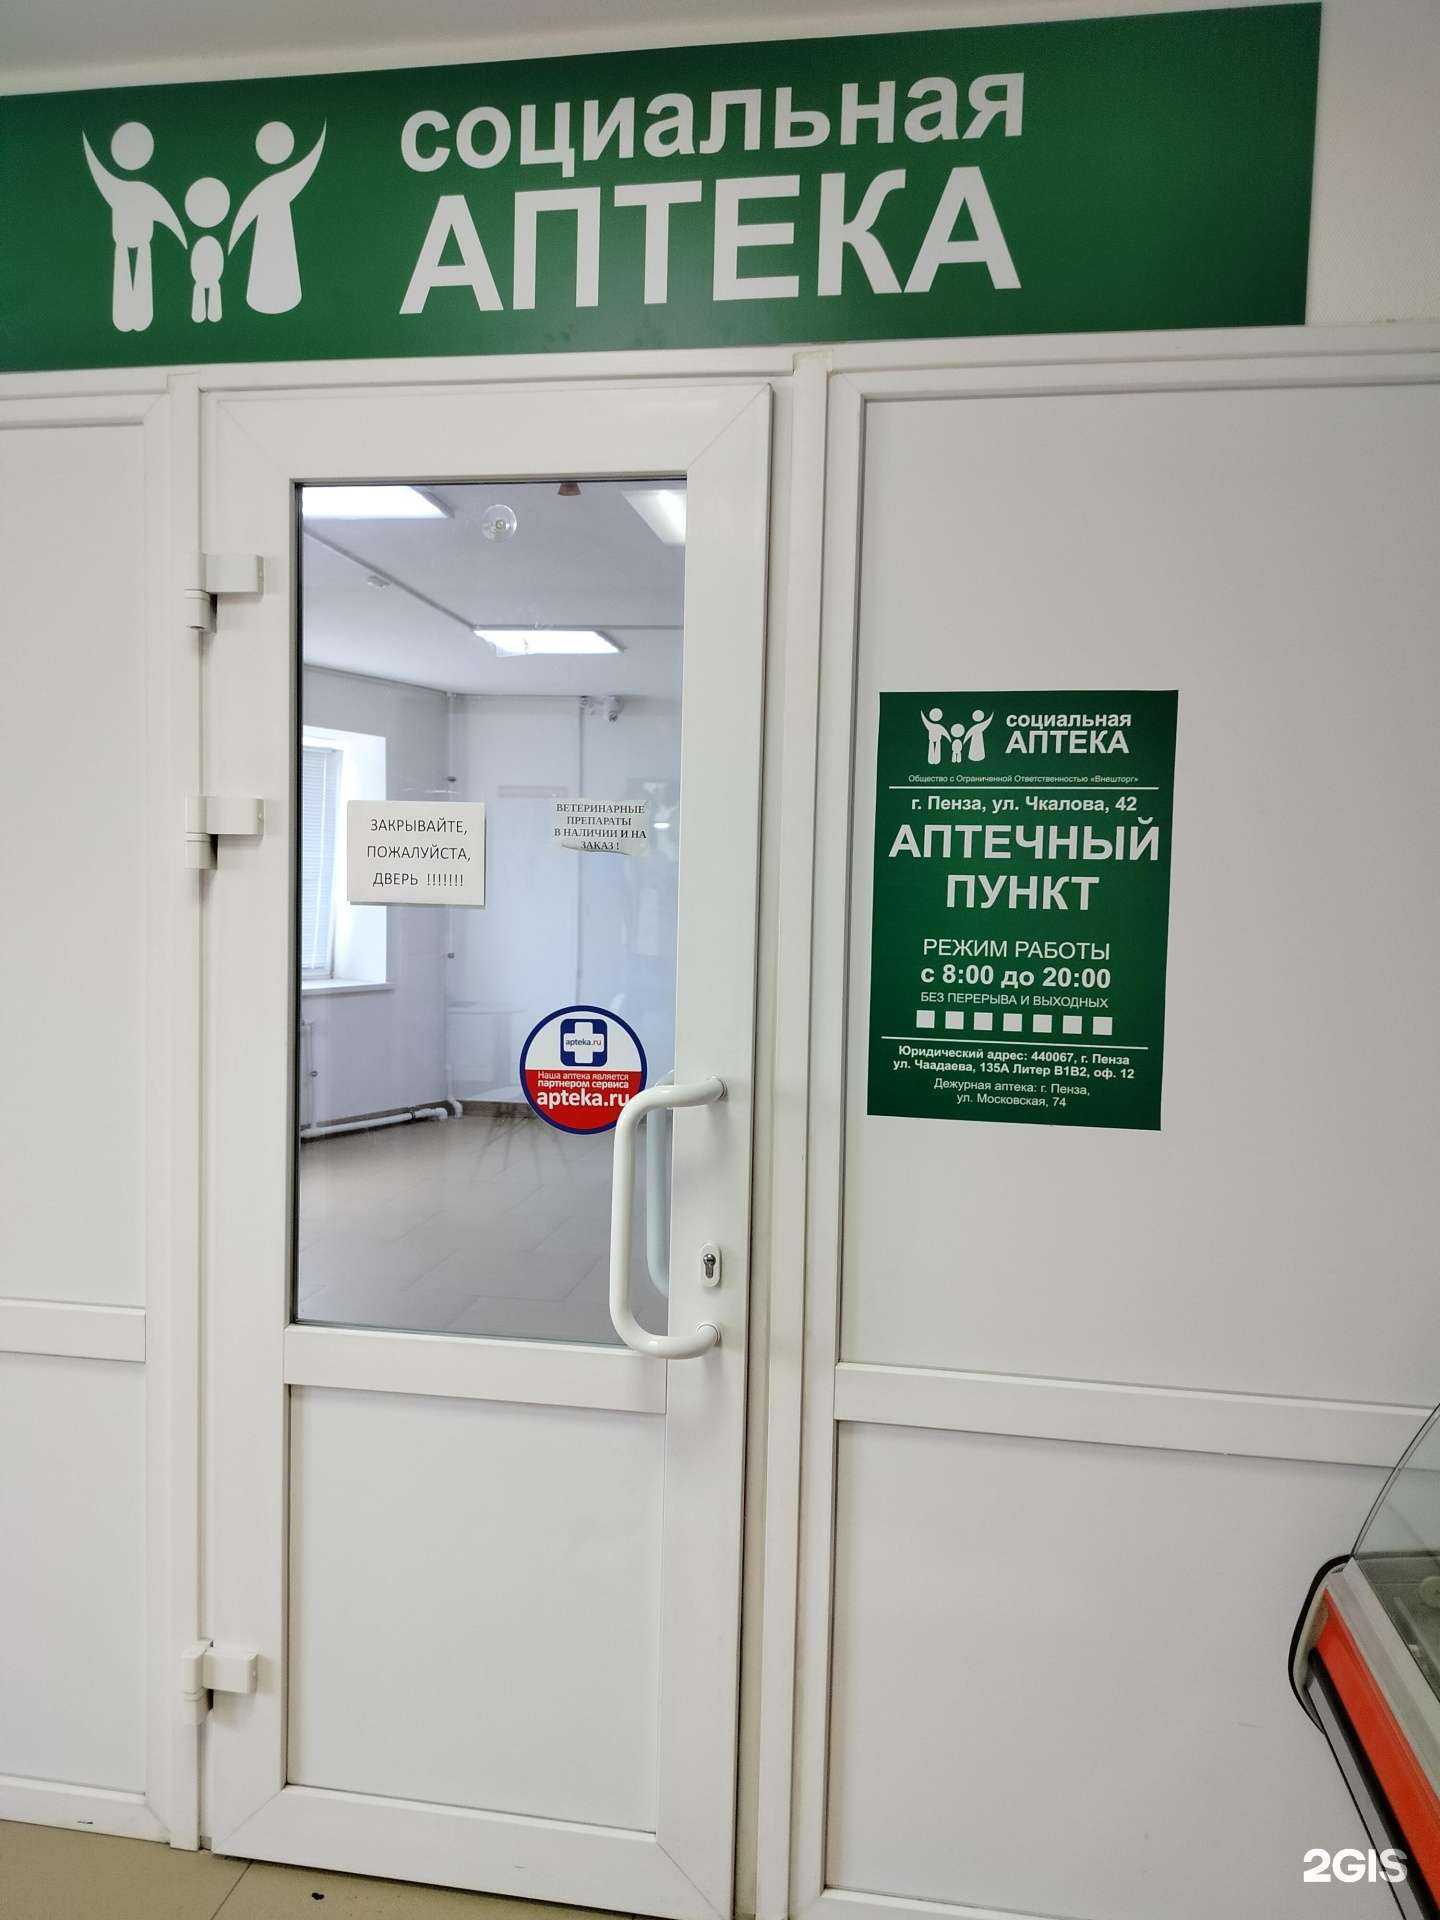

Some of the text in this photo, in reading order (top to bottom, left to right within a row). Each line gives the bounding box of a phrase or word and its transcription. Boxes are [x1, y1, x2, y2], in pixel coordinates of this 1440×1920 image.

[401, 72, 1025, 178] социальная
[399, 165, 1022, 315] АПТЕКА
[1006, 713, 1132, 730] социальная
[1005, 729, 1130, 754] АПТЕКА
[908, 775, 948, 783] Общество
[956, 775, 1012, 784] Ограниченной
[1014, 775, 1088, 784] Ответственностью
[556, 803, 645, 814] ВЕТЕРИНАРНЫЕ
[911, 795, 1137, 813] г. Пенза, ул. Чкалова, 42
[370, 817, 468, 836] ЗАКРЫВАЙТЕ,
[567, 816, 632, 826] ПРЕПАРАТЫ
[554, 828, 647, 839] В НАЛИЧИИ И НА
[888, 816, 1160, 861] АПТЕЧНЫЙ
[367, 844, 471, 862] ПОЖАЛУЙСТА,
[580, 840, 614, 850] ЗАКАЗ
[372, 871, 463, 887] ДВЕРЬ !!!!!!!
[946, 874, 1100, 911] ПУНКТ
[923, 938, 1110, 960] РЕЖИМ РАБОТЫ
[921, 964, 1111, 989] с 8:00 до 20:00
[921, 992, 1109, 1009] БЕЗ ПЕРЕРЫВА И ВЫХОДНЫХ
[566, 1037, 602, 1048] apteka.ru
[899, 1045, 1130, 1065] Юридический адрес: 440067, г. Пенза
[538, 1071, 629, 1081] Наша аптека является
[893, 1059, 911, 1070] ул.
[914, 1059, 976, 1073] Чаадаева,
[980, 1062, 1010, 1073] 135А
[1012, 1063, 1051, 1077] Литер
[1093, 1067, 1117, 1080] оф.
[1120, 1068, 1135, 1079] 12
[538, 1080, 629, 1090] партнером сервиса
[933, 1077, 1090, 1096] Дежурная аптека: г. Пенза,
[537, 1088, 629, 1109] apteka.ru
[956, 1093, 1067, 1107] ул. Московская, 74
